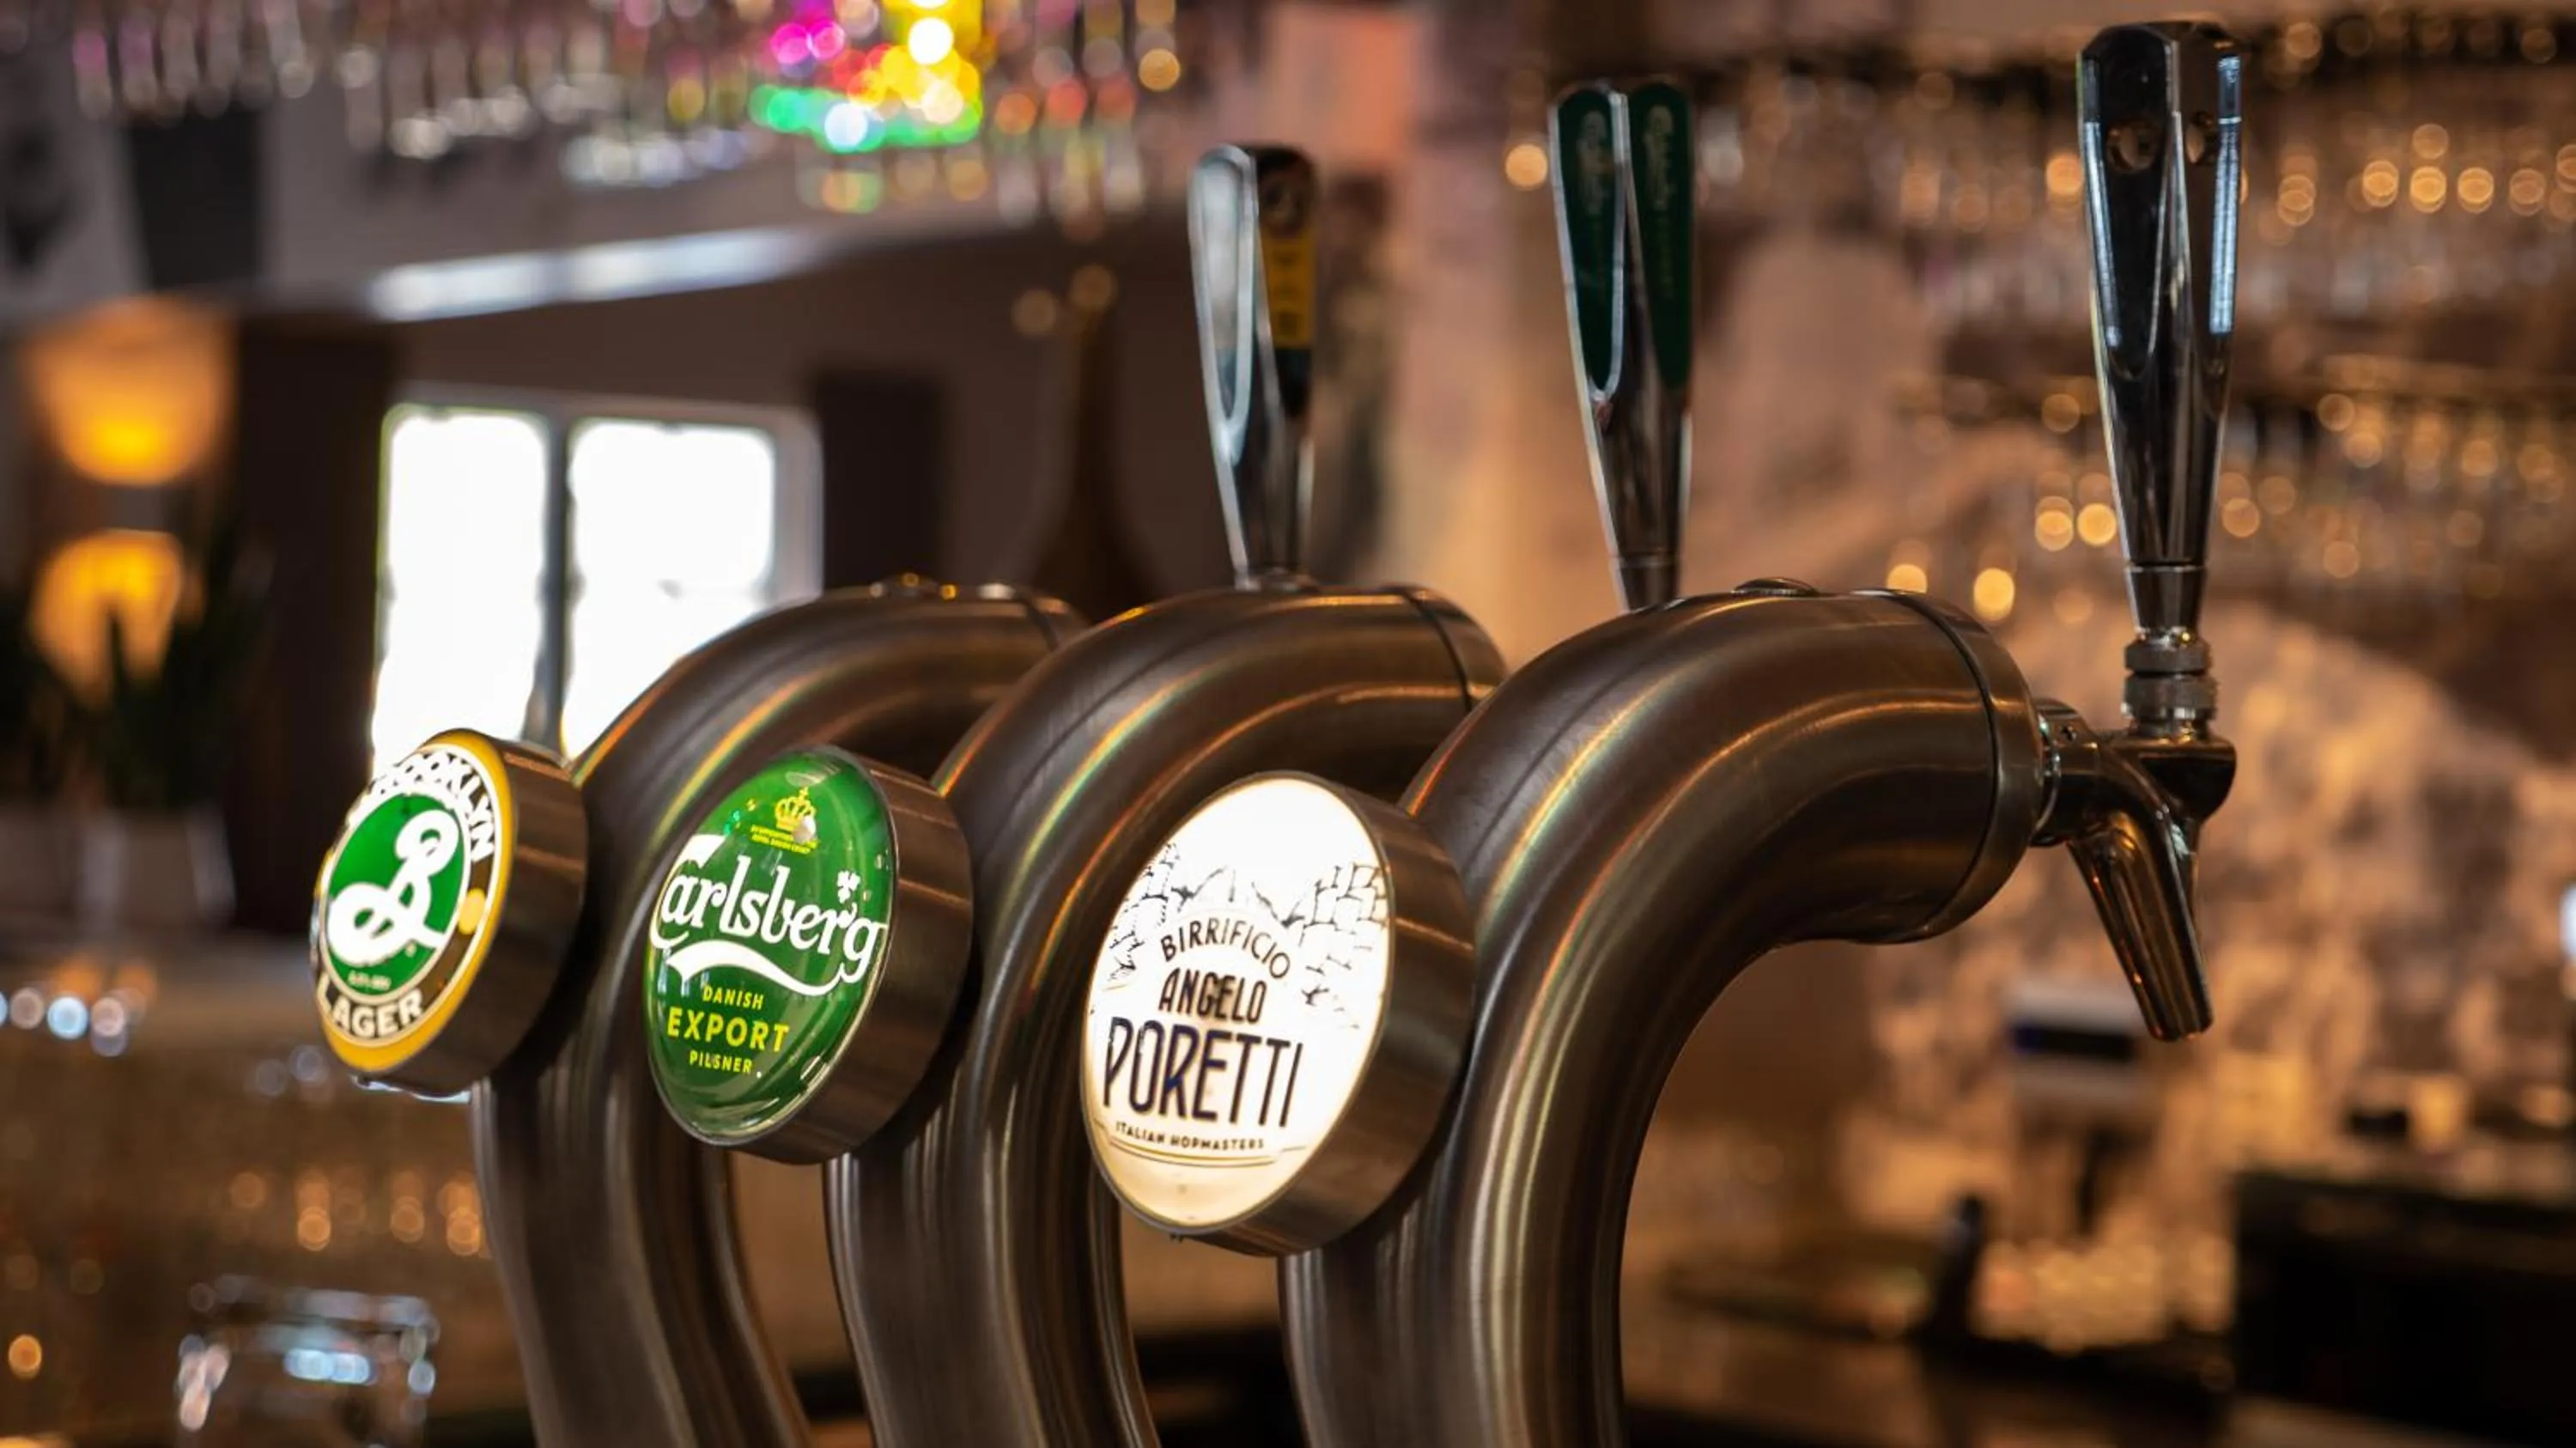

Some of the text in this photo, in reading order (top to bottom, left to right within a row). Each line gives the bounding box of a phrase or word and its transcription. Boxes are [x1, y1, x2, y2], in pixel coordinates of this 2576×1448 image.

[350, 745, 495, 862] OOKLYN
[650, 834, 888, 985] Carlsberg
[1161, 917, 1291, 979] BIRRIFICIO
[317, 971, 422, 1038] LAGER
[702, 985, 764, 1011] DANISH
[1158, 967, 1267, 1025] ANGELO
[667, 1006, 790, 1053] EXPORT
[690, 1049, 753, 1074] PILSNER
[1103, 1016, 1303, 1129] PORETTI
[1115, 1121, 1266, 1152] ITALIAN HOPMASTERS
